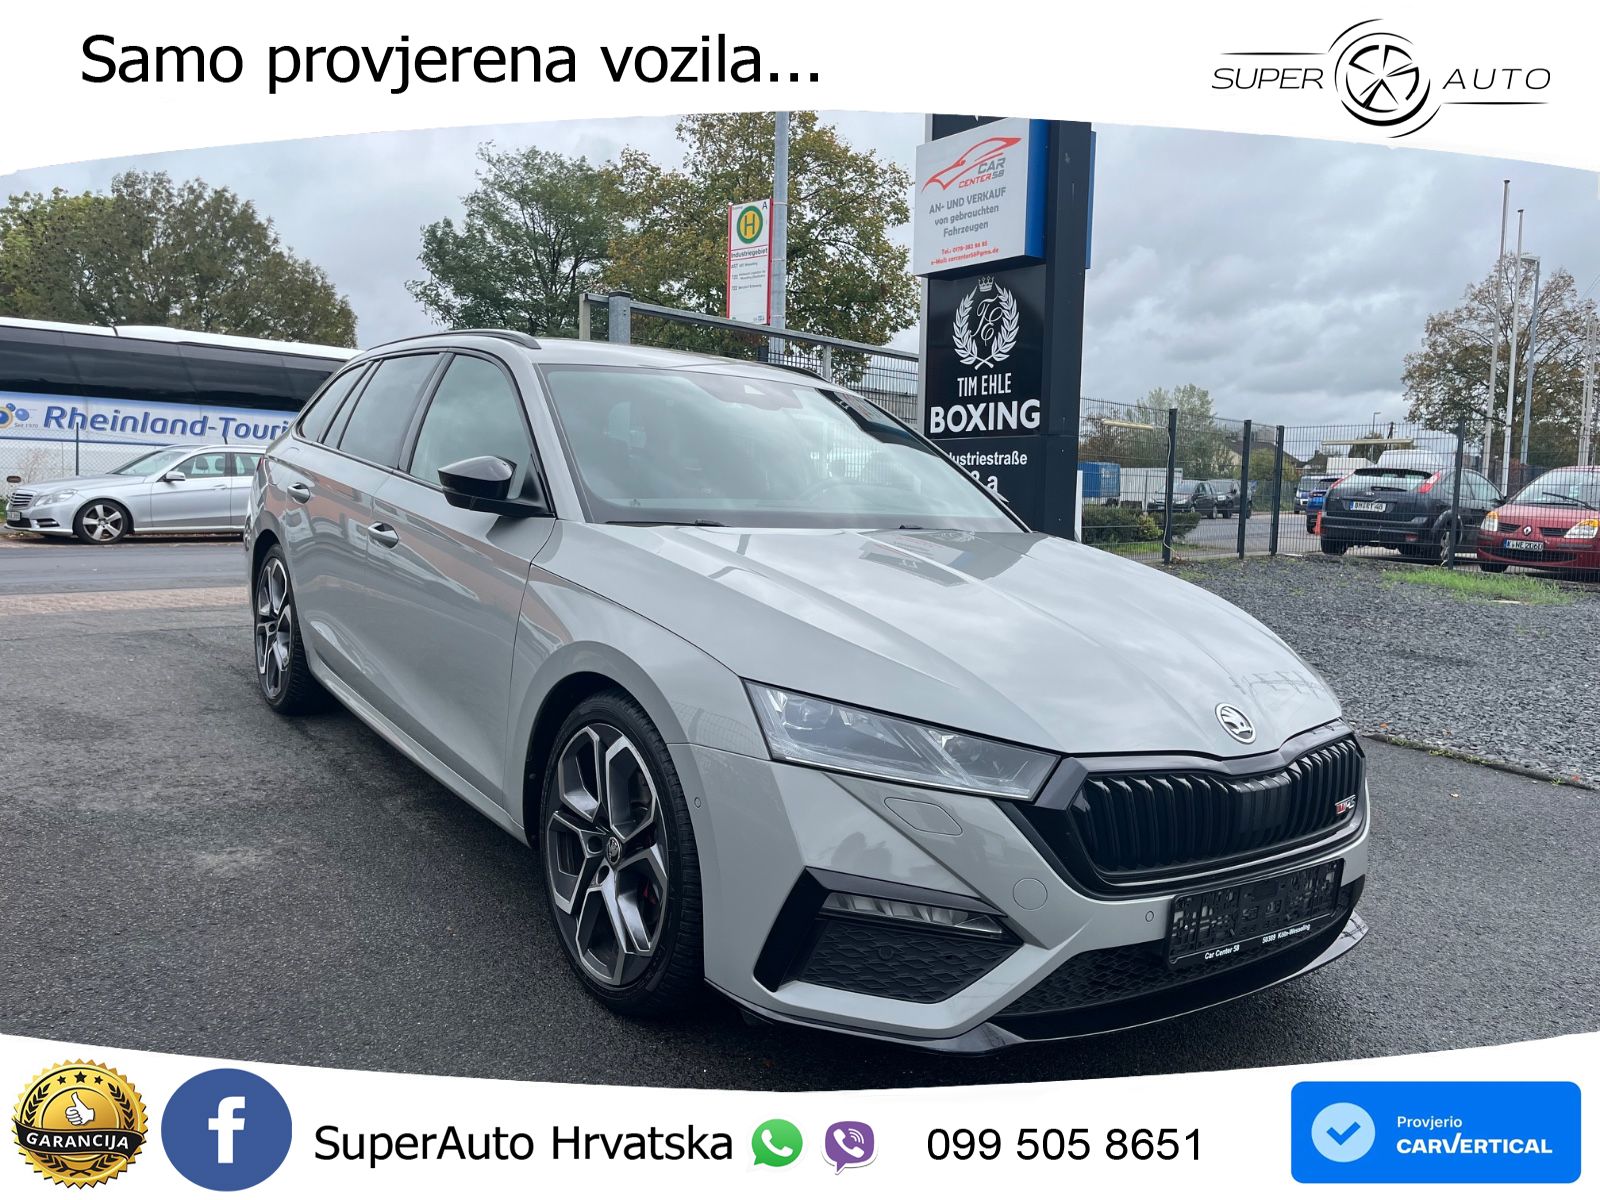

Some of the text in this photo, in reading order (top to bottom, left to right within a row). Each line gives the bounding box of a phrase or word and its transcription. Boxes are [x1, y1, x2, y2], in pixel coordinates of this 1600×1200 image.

[977, 157, 1006, 175] CAR
[762, 201, 768, 210] A
[929, 186, 1007, 215] AN- UND VERKAUF
[934, 205, 999, 226] von gebrauchten
[943, 220, 989, 237] Fahrzeugen
[957, 372, 1012, 397] TIM EHLE
[930, 398, 1041, 434] BOXING
[1204, 951, 1215, 960] Car
[1215, 947, 1233, 957] Center
